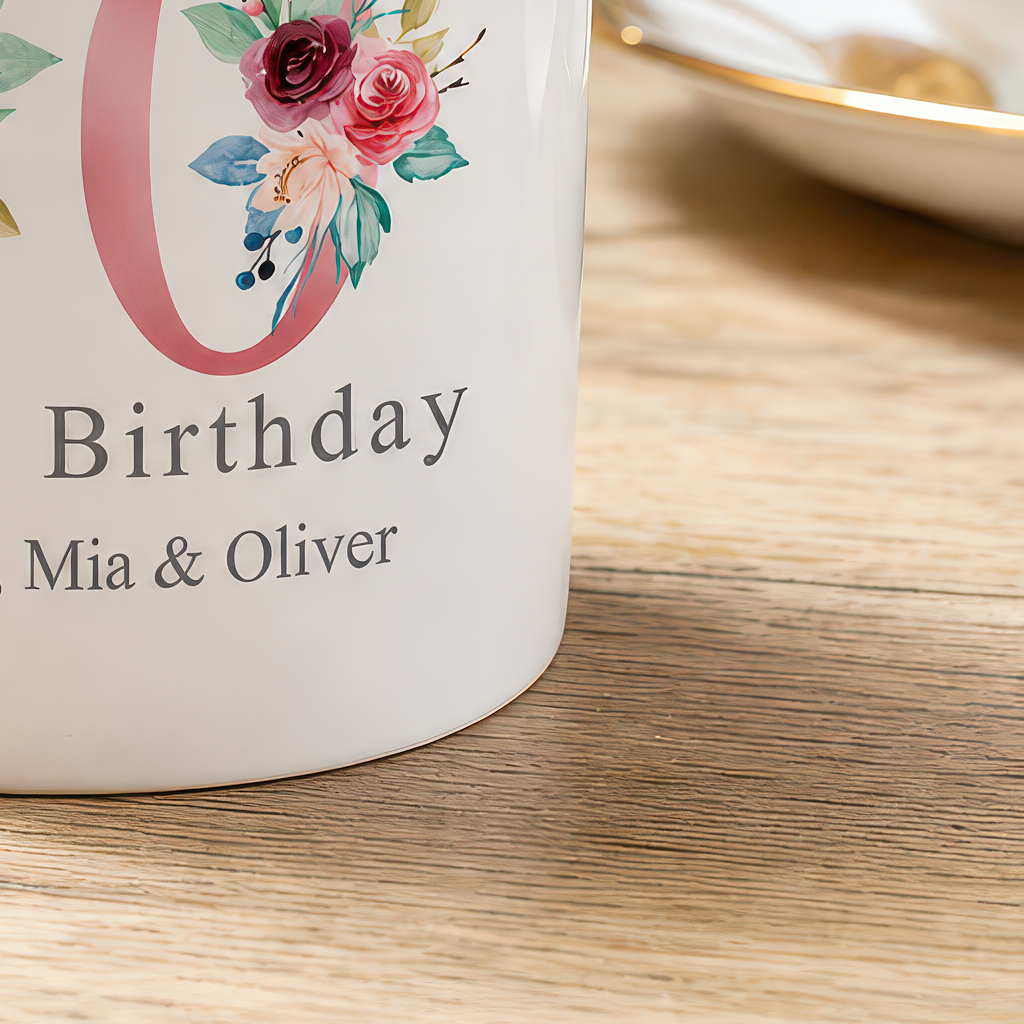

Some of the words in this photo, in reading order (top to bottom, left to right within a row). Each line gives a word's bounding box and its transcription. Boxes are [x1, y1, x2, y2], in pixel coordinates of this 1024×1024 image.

[43, 382, 469, 480] Birthday
[23, 536, 136, 592] Mia
[154, 534, 205, 589] &
[225, 520, 400, 584] Oliver
